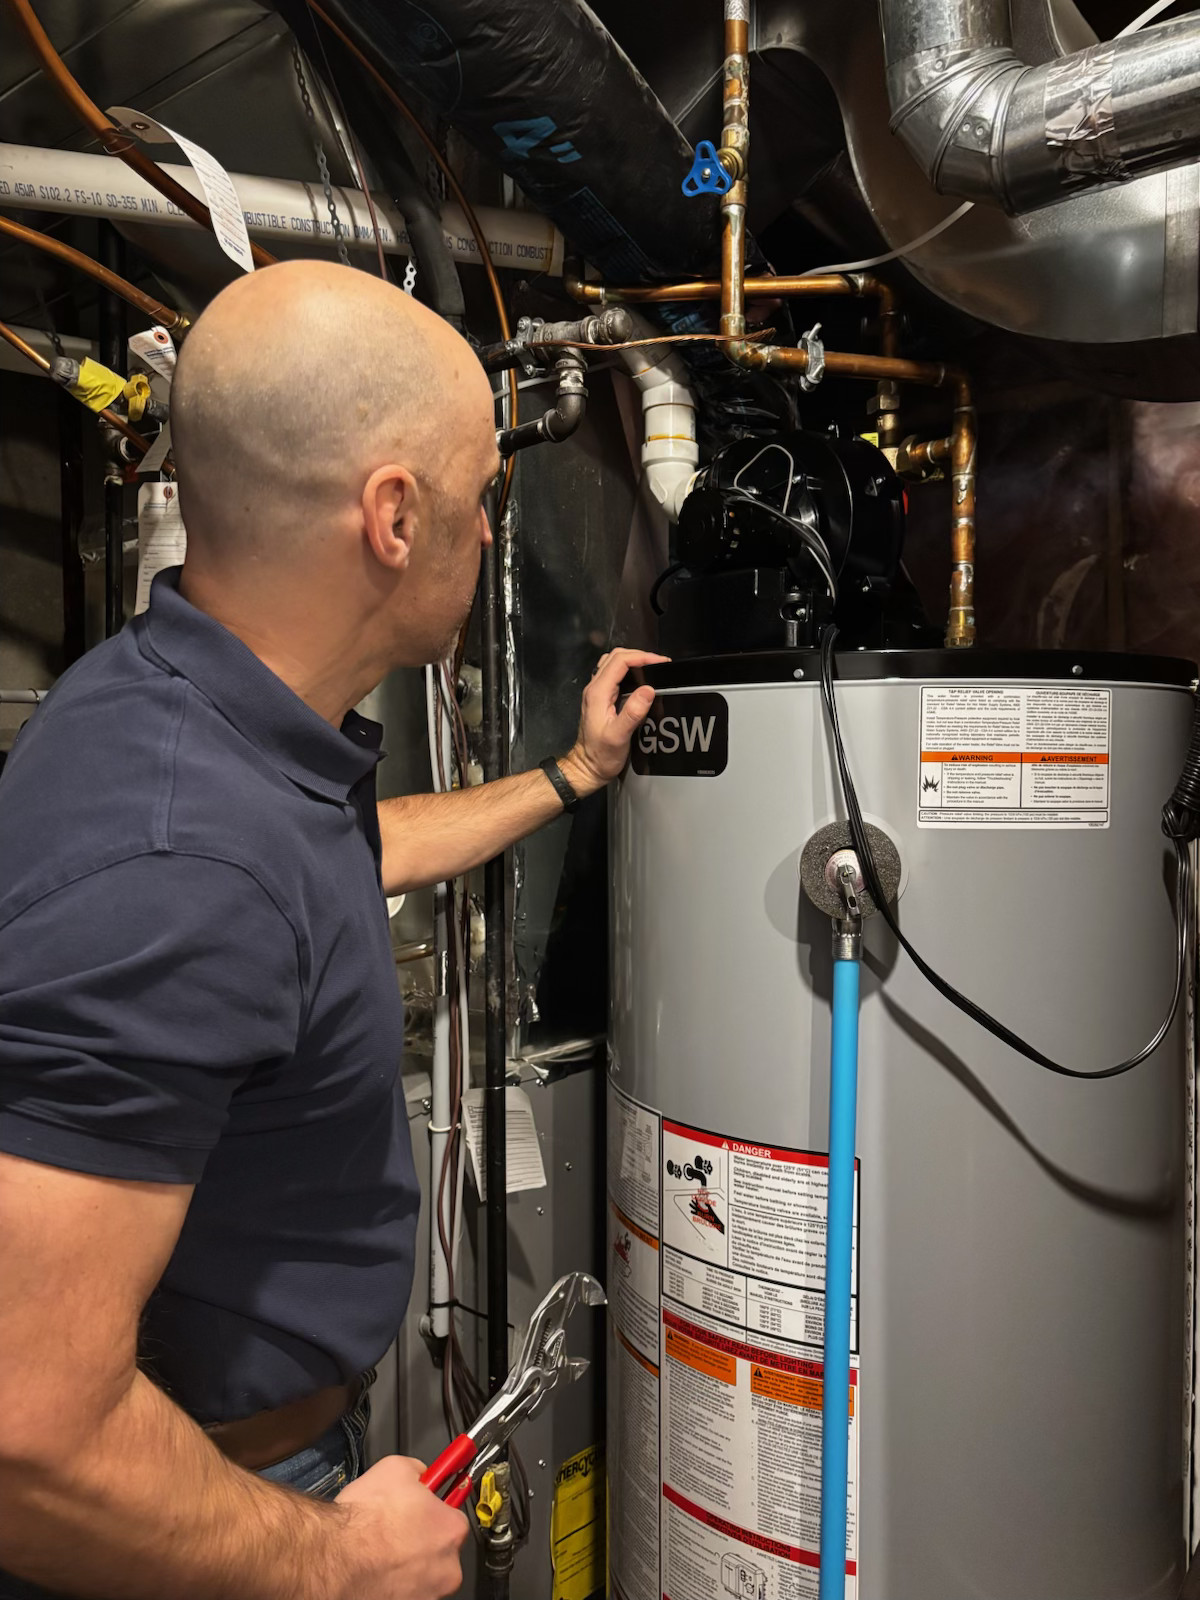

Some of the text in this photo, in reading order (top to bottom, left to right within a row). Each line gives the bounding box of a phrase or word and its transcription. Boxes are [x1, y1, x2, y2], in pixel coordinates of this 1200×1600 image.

[40, 185, 72, 203] S102.2
[74, 189, 102, 206] FS-10
[106, 193, 138, 211] SD-355
[141, 198, 162, 214] MIN.
[242, 211, 288, 229] MBUSTIBLE
[639, 716, 716, 754] GSW
[732, 1143, 771, 1158] DANGER
[708, 1330, 731, 1345] SAFETY
[732, 1340, 749, 1351] READ
[751, 1346, 778, 1360] BEFORE
[780, 1354, 814, 1369] LIGHTING
[739, 1350, 758, 1361] AVANT
[770, 1358, 796, 1371] METTRE
[706, 1512, 791, 1551] OPERATING INSTRUCTIONS
